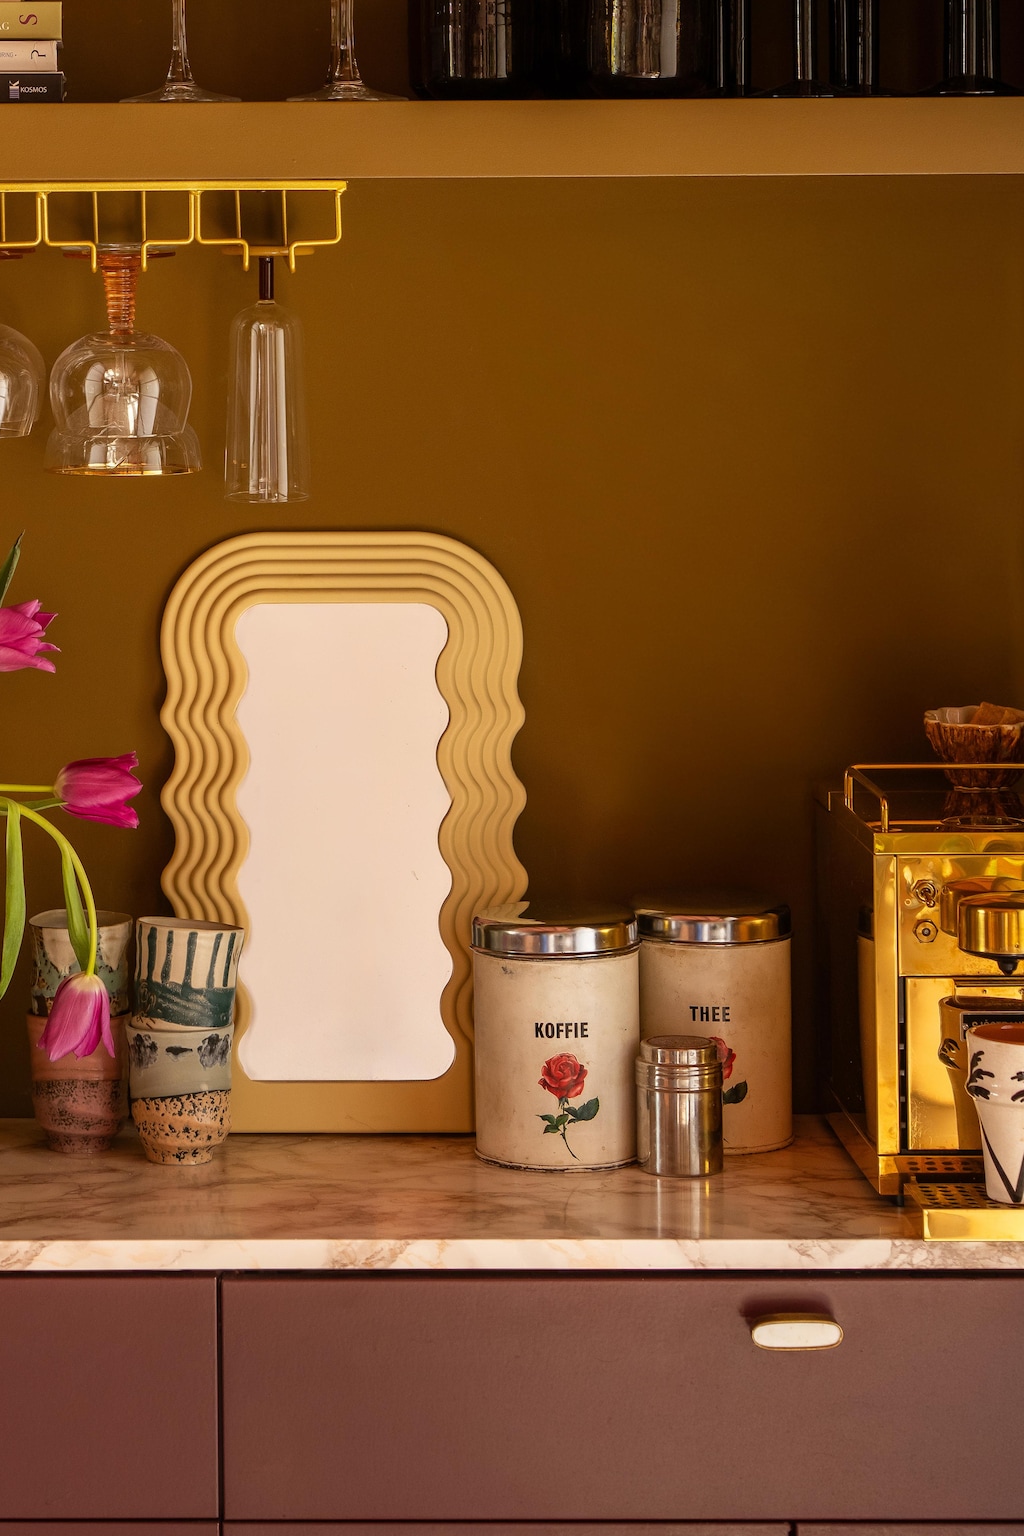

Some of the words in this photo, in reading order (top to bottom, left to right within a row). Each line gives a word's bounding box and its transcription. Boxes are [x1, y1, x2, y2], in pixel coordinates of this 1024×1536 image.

[20, 86, 48, 94] KOSMOS
[689, 1006, 731, 1022] THEE
[534, 1022, 589, 1038] KOFFIE
